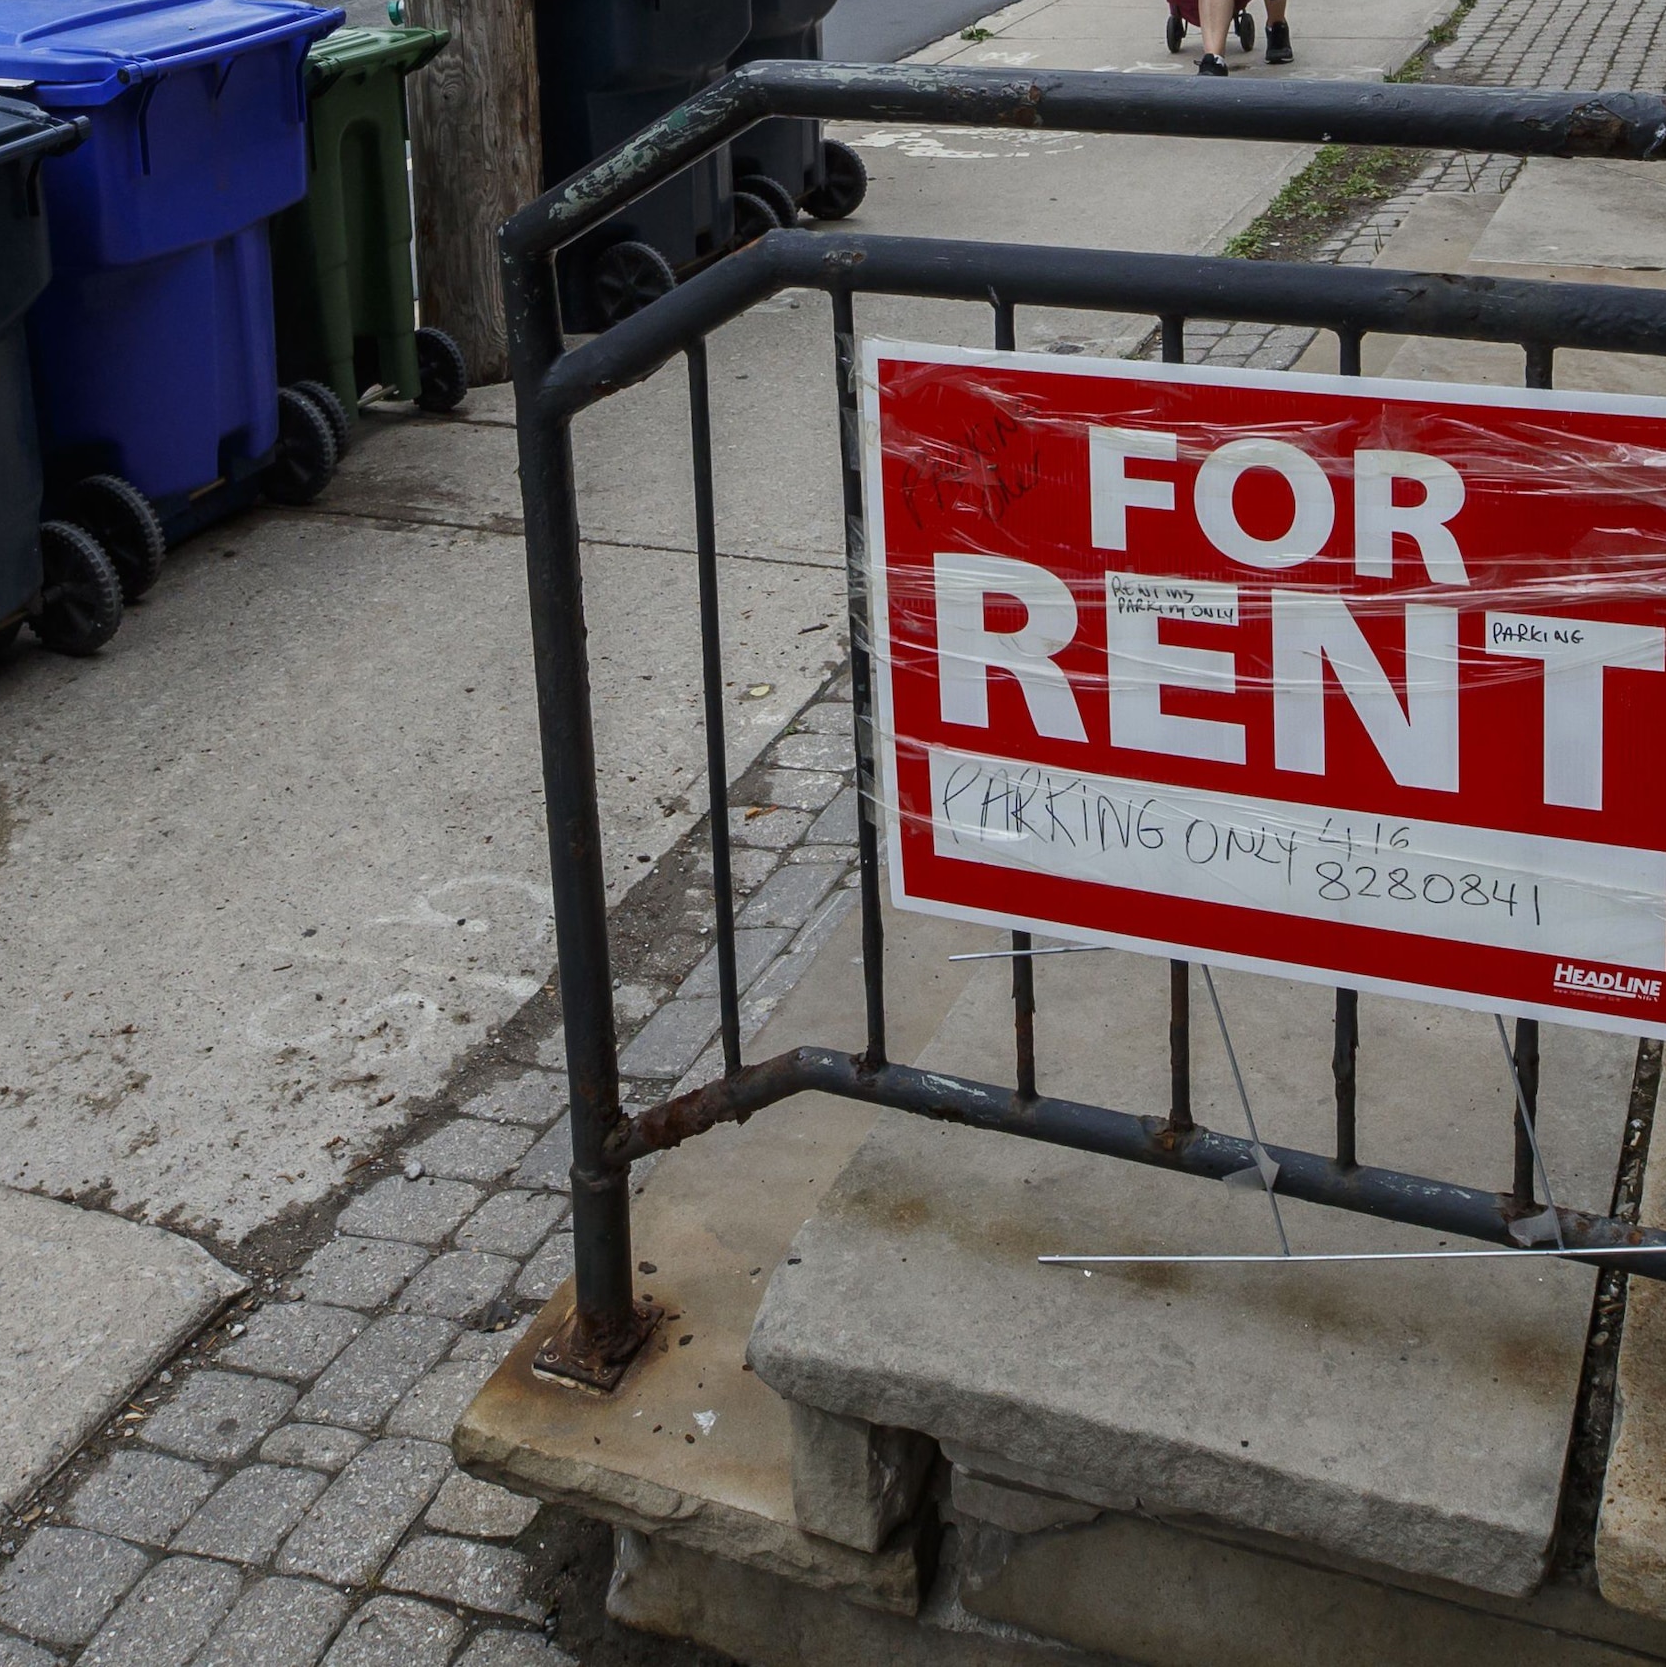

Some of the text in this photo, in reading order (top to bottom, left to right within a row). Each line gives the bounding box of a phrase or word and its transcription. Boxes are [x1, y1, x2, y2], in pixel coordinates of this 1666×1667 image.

[1088, 424, 1469, 587] FOR
[1191, 604, 1234, 623] ONLY
[1493, 621, 1584, 645] PARKING
[932, 551, 1666, 813] RENT
[942, 759, 1412, 886] PARKING ONLY 416
[1315, 860, 1542, 926] 8280841
[1553, 962, 1663, 997] HEADLINE
